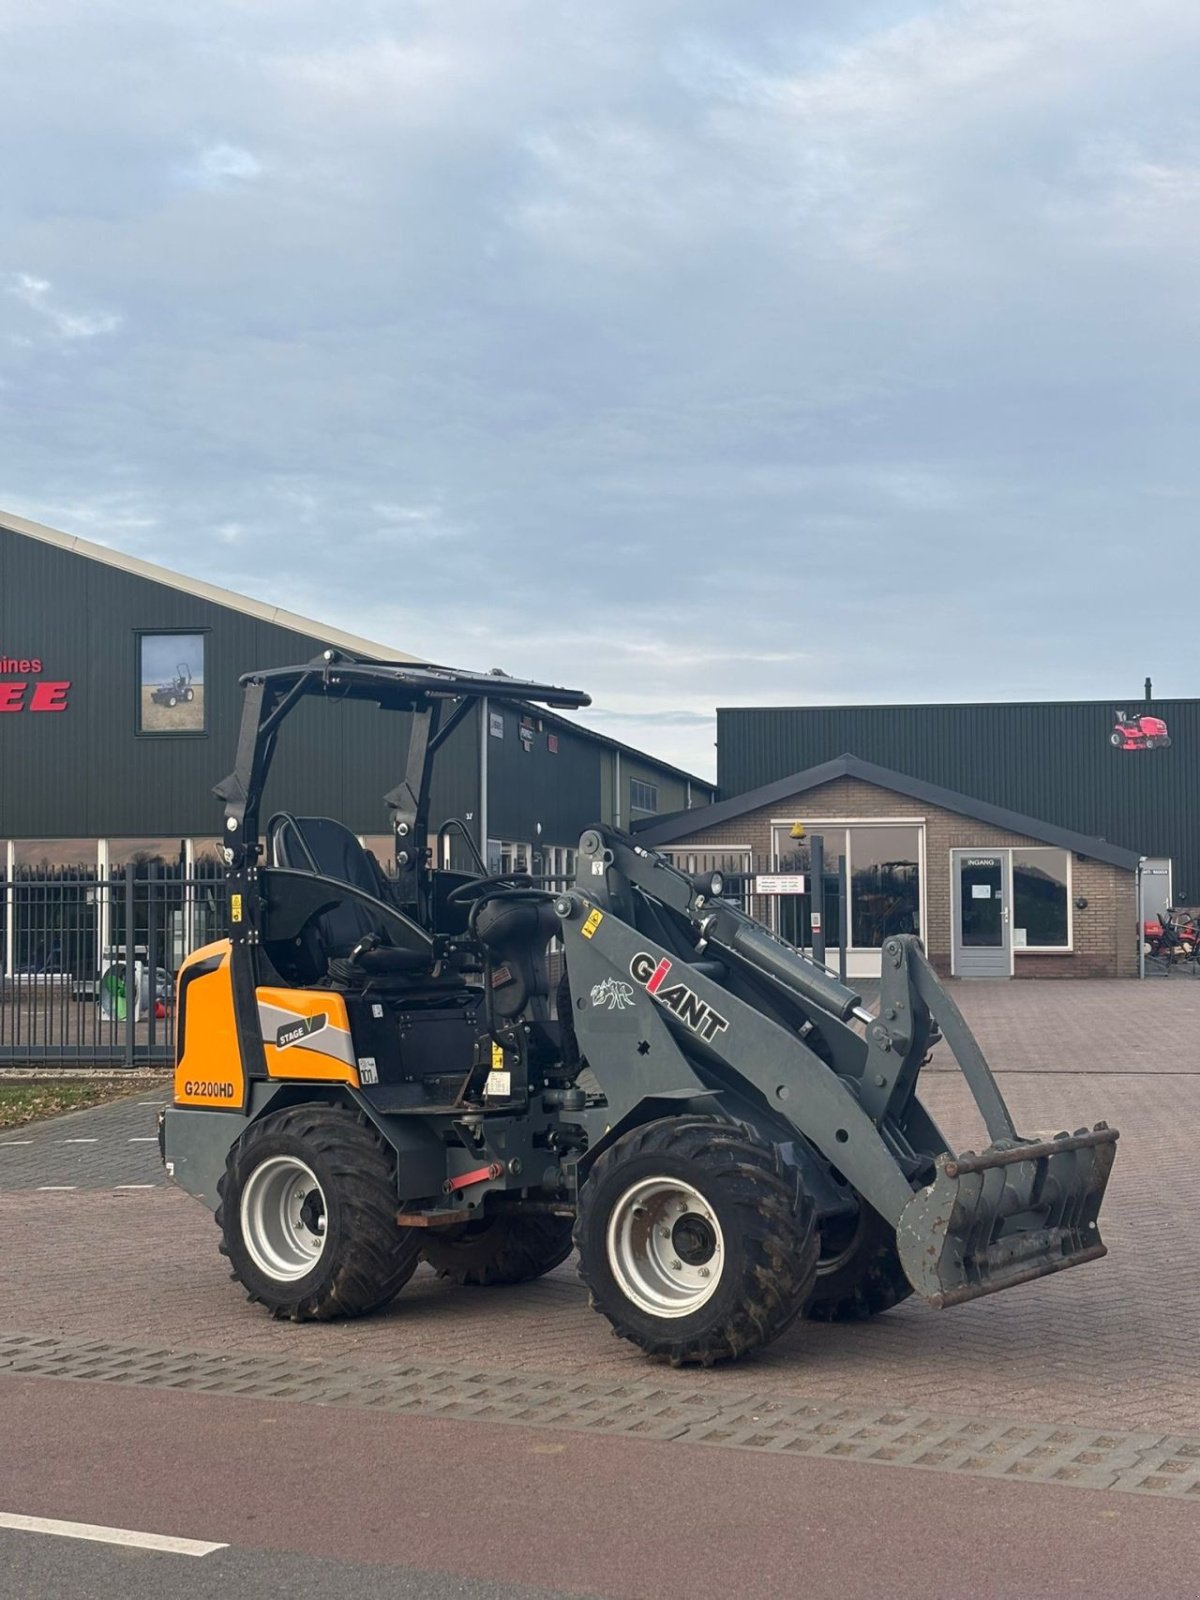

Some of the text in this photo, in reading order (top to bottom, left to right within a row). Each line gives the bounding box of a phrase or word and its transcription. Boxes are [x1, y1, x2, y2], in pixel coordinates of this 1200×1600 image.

[0, 656, 42, 673] ines
[280, 1027, 304, 1045] STAGE
[185, 1081, 234, 1098] G2200HD
